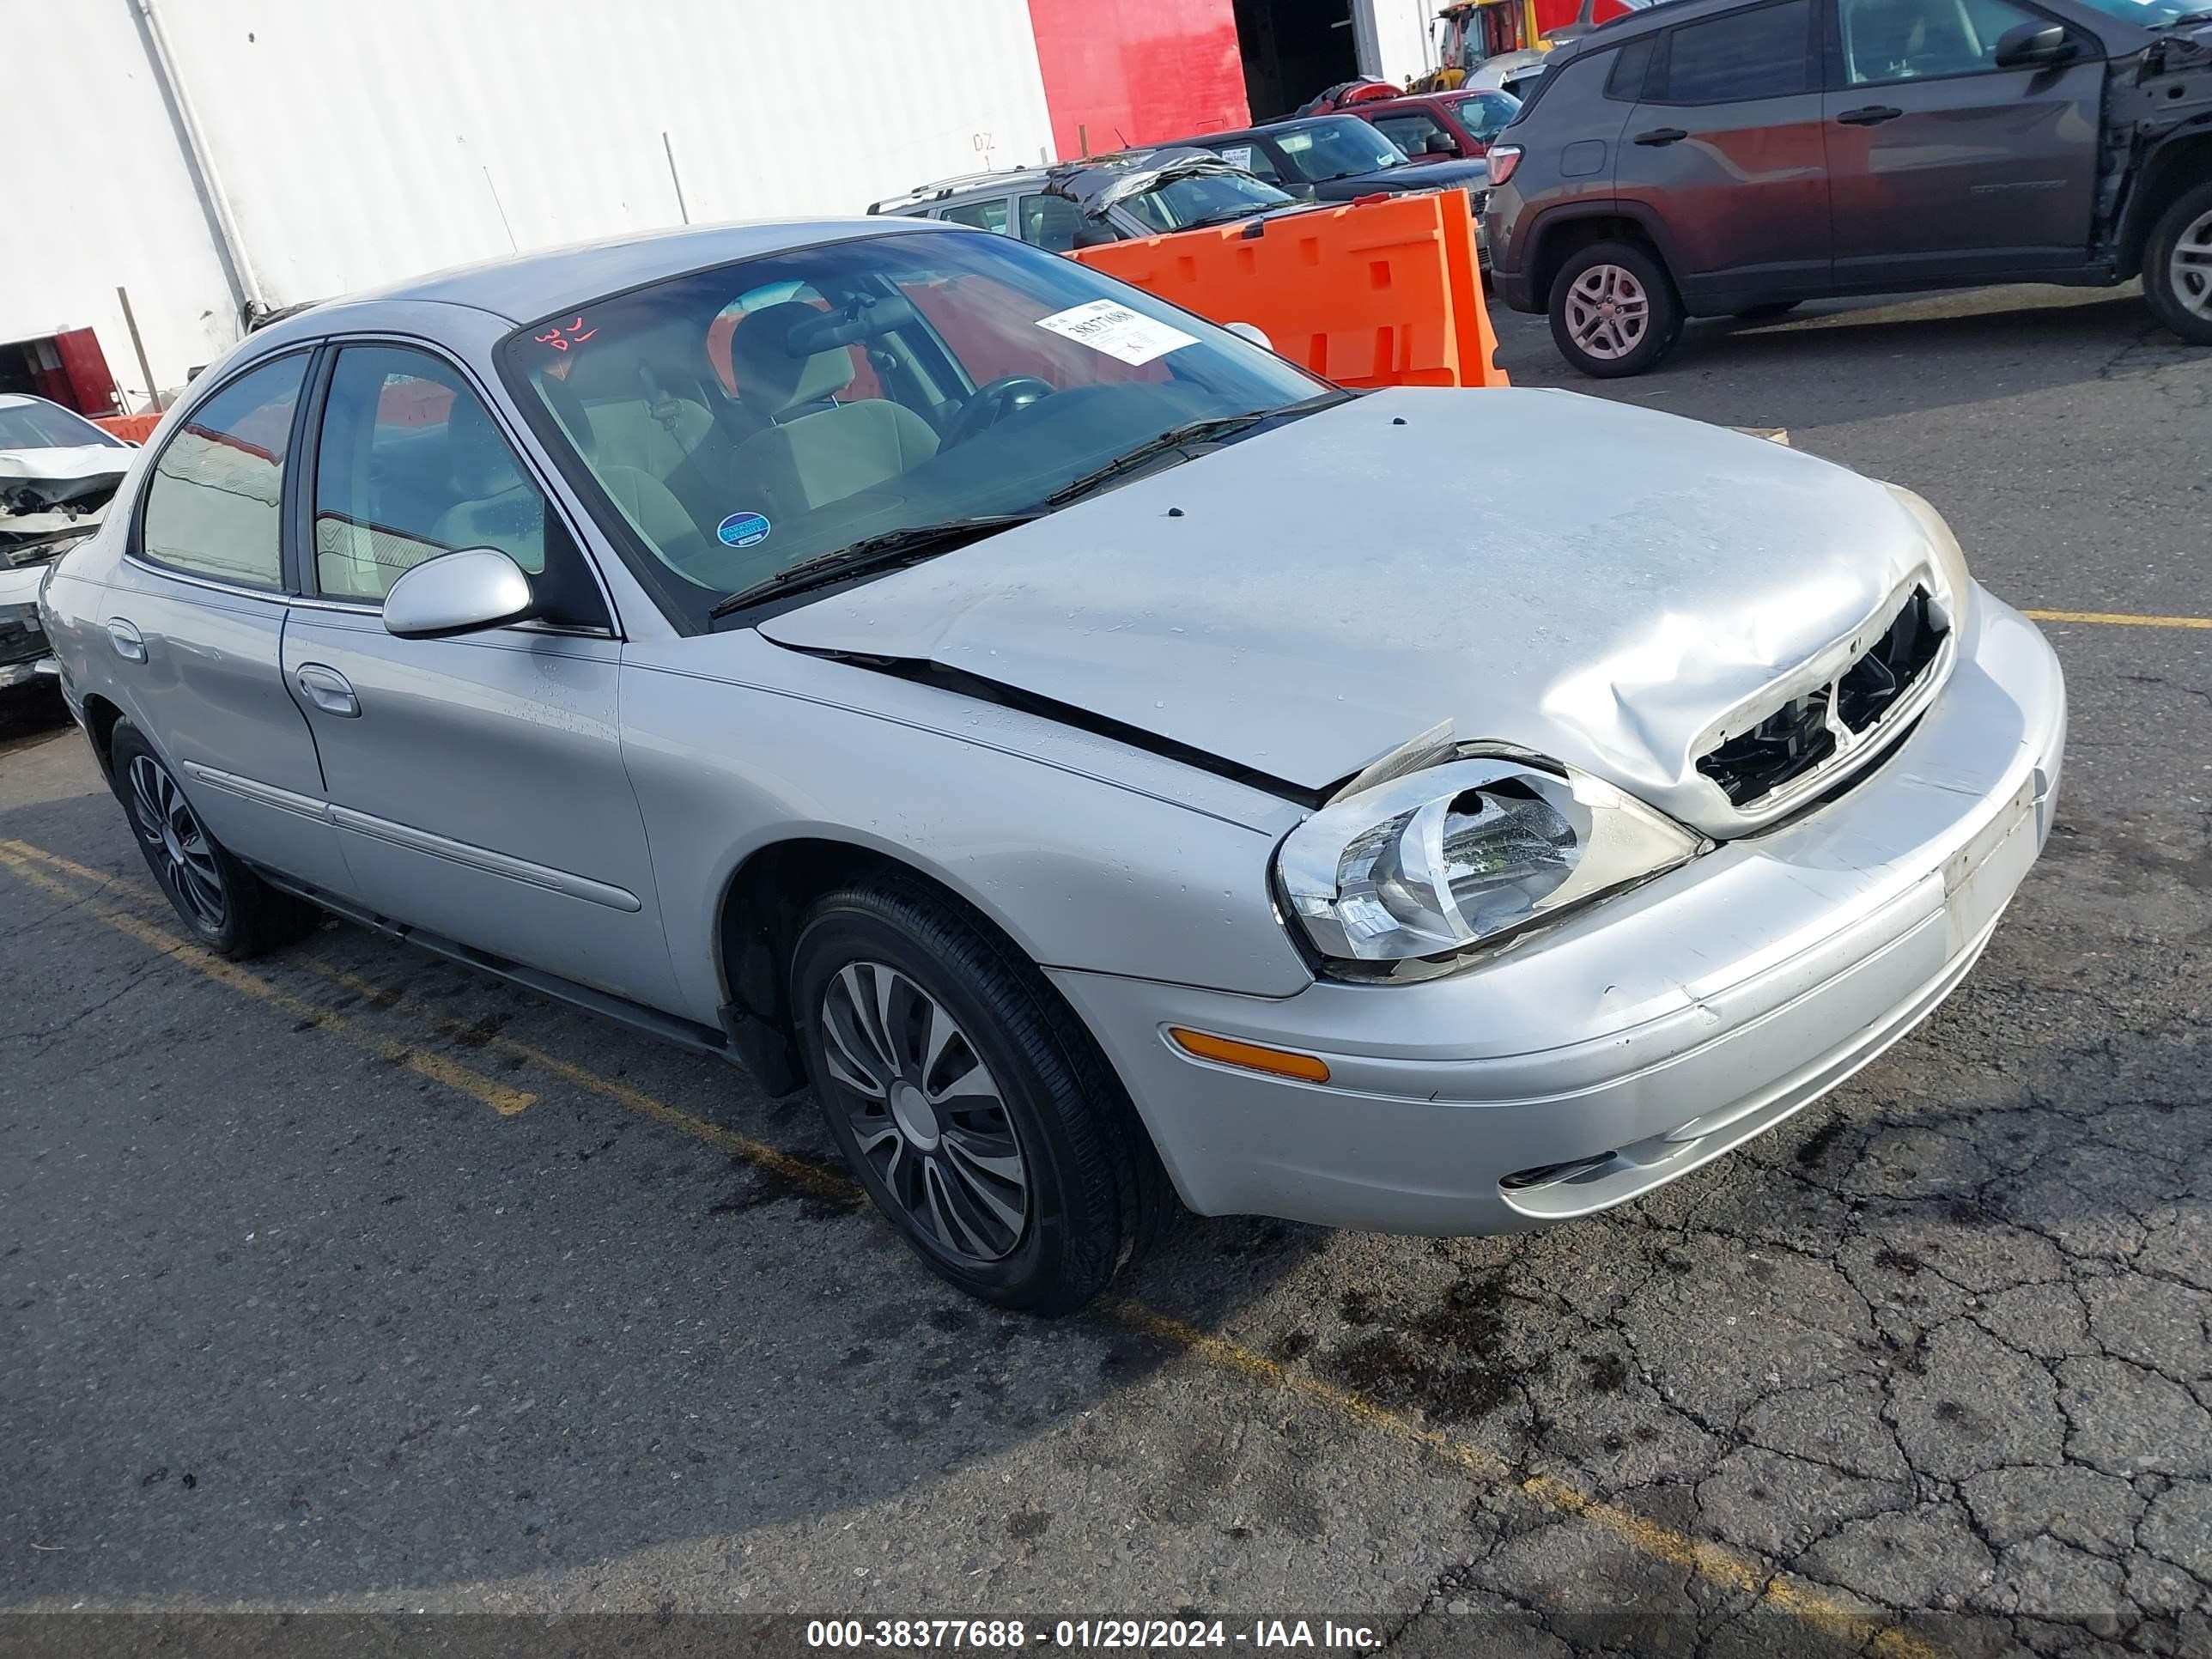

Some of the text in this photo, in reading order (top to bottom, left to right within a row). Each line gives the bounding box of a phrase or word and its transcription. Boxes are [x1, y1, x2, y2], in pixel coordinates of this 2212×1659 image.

[1068, 310, 1135, 337] 38377688
[723, 518, 762, 535] PARKING
[729, 525, 761, 540] PERMIT
